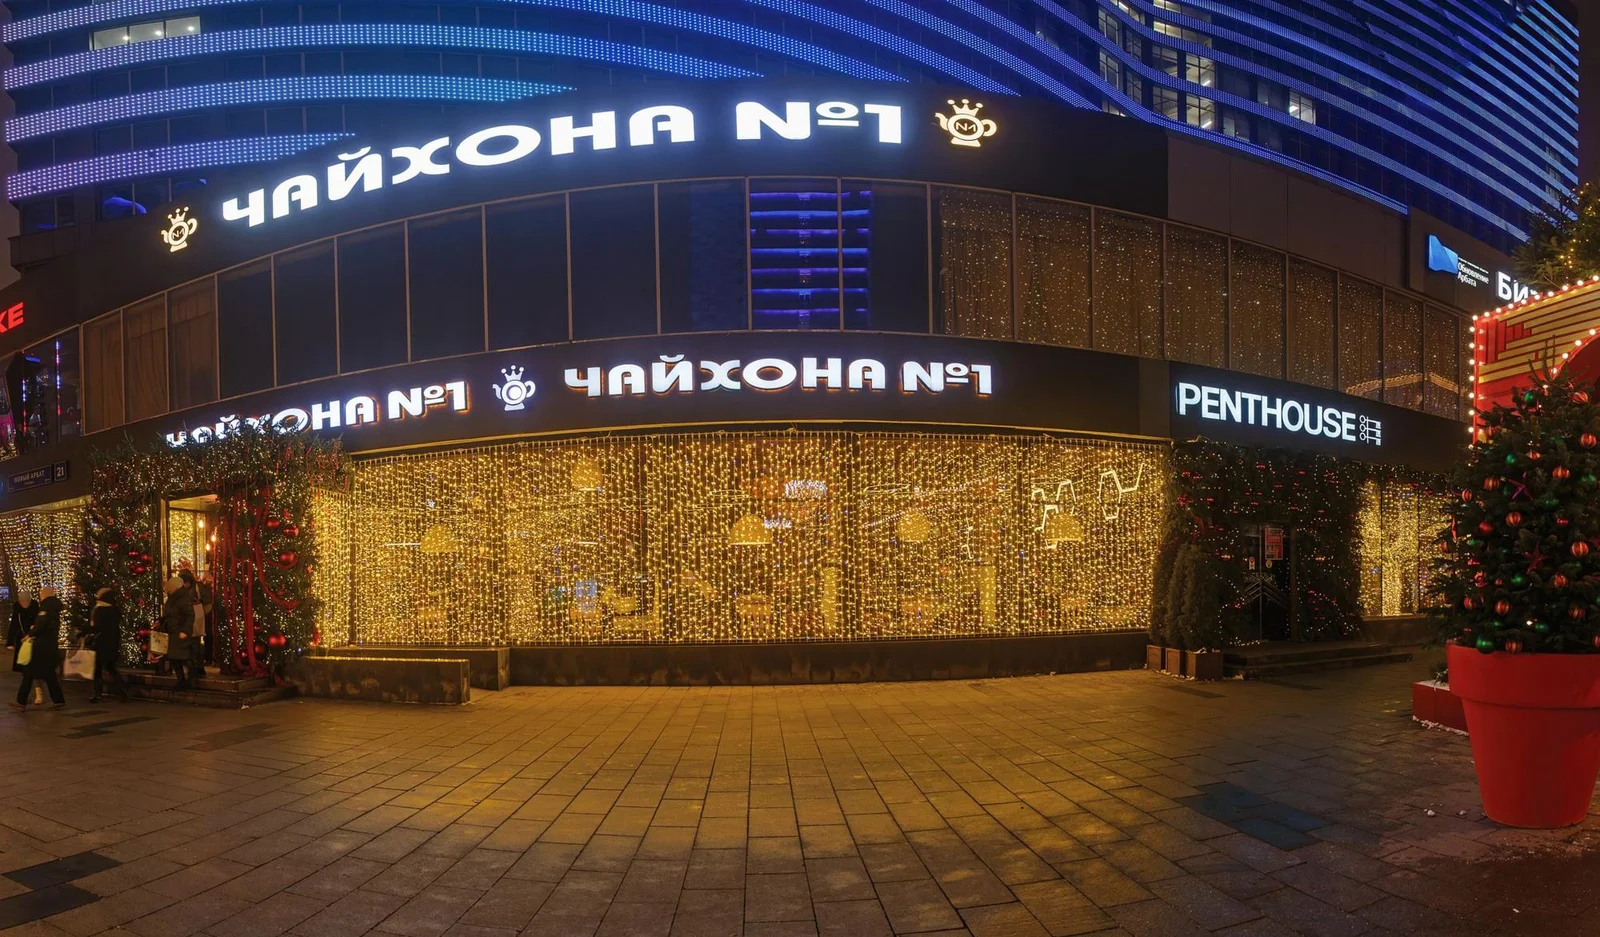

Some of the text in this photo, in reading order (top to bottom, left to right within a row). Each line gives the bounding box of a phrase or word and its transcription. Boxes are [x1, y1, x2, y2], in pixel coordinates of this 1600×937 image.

[222, 105, 695, 228] ЧАЙХОНА
[564, 354, 886, 397] ЧАЙХОНА
[1178, 382, 1356, 442] PENTHOUSE
[56, 467, 64, 477] 21
